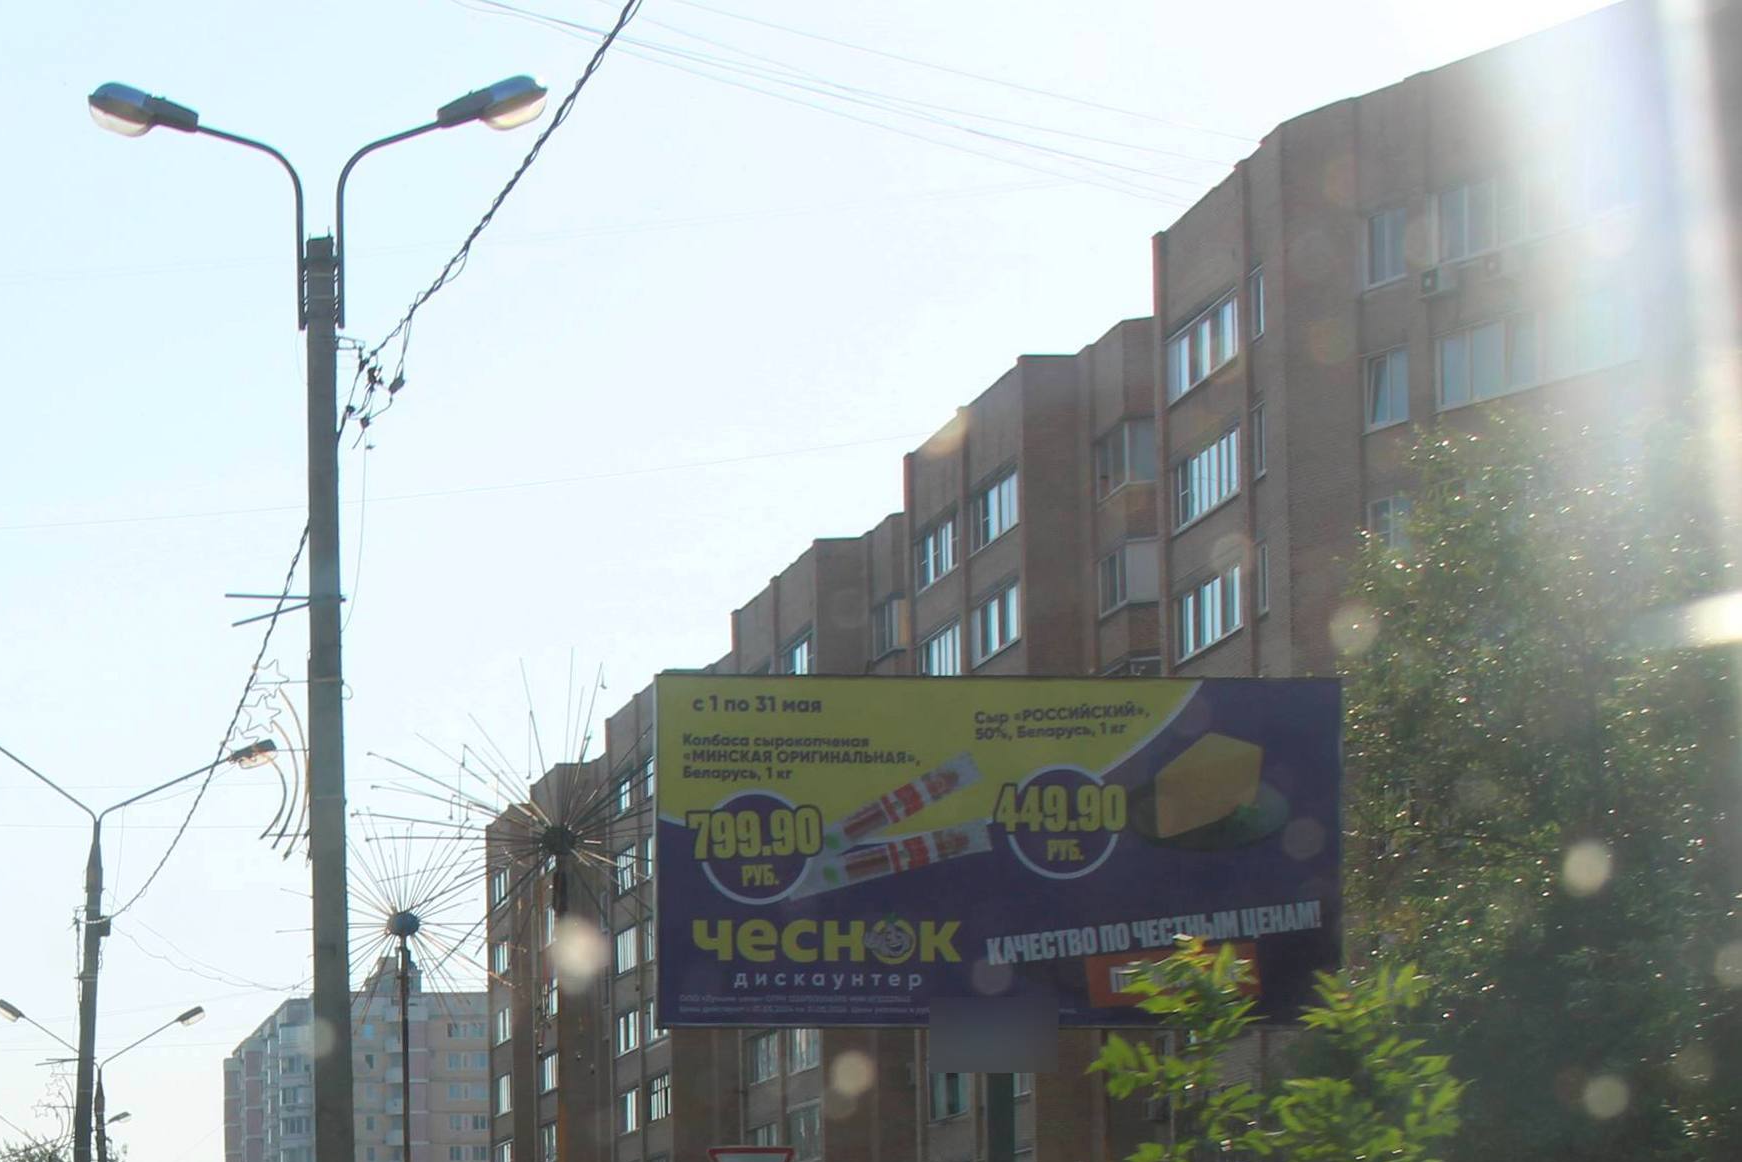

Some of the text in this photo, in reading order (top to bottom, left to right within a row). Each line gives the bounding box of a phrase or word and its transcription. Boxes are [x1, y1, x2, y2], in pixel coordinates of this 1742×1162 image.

[692, 696, 823, 712] с 1 по 31 мая
[974, 700, 1150, 725] Сыр «РОССИЙСКИЙ»,
[682, 733, 870, 750] Колбаса сырокопченая
[975, 722, 1127, 741] 50%, Беларусь, 1 кг
[682, 750, 921, 767] «МИНСКАЯ ОРИГИНАЛЬНАЯ»,
[682, 766, 793, 781] Беларусь, 1 кг
[994, 783, 1127, 833] 449.90
[687, 805, 823, 860] 799.90
[1046, 838, 1085, 863] РУБ.
[741, 864, 780, 887] РУБ.
[985, 900, 1322, 966] КАЧЕСТВО ПО ЧЕСТНЫМ ЦЕНАМ!
[733, 972, 923, 991] дискаунтер
